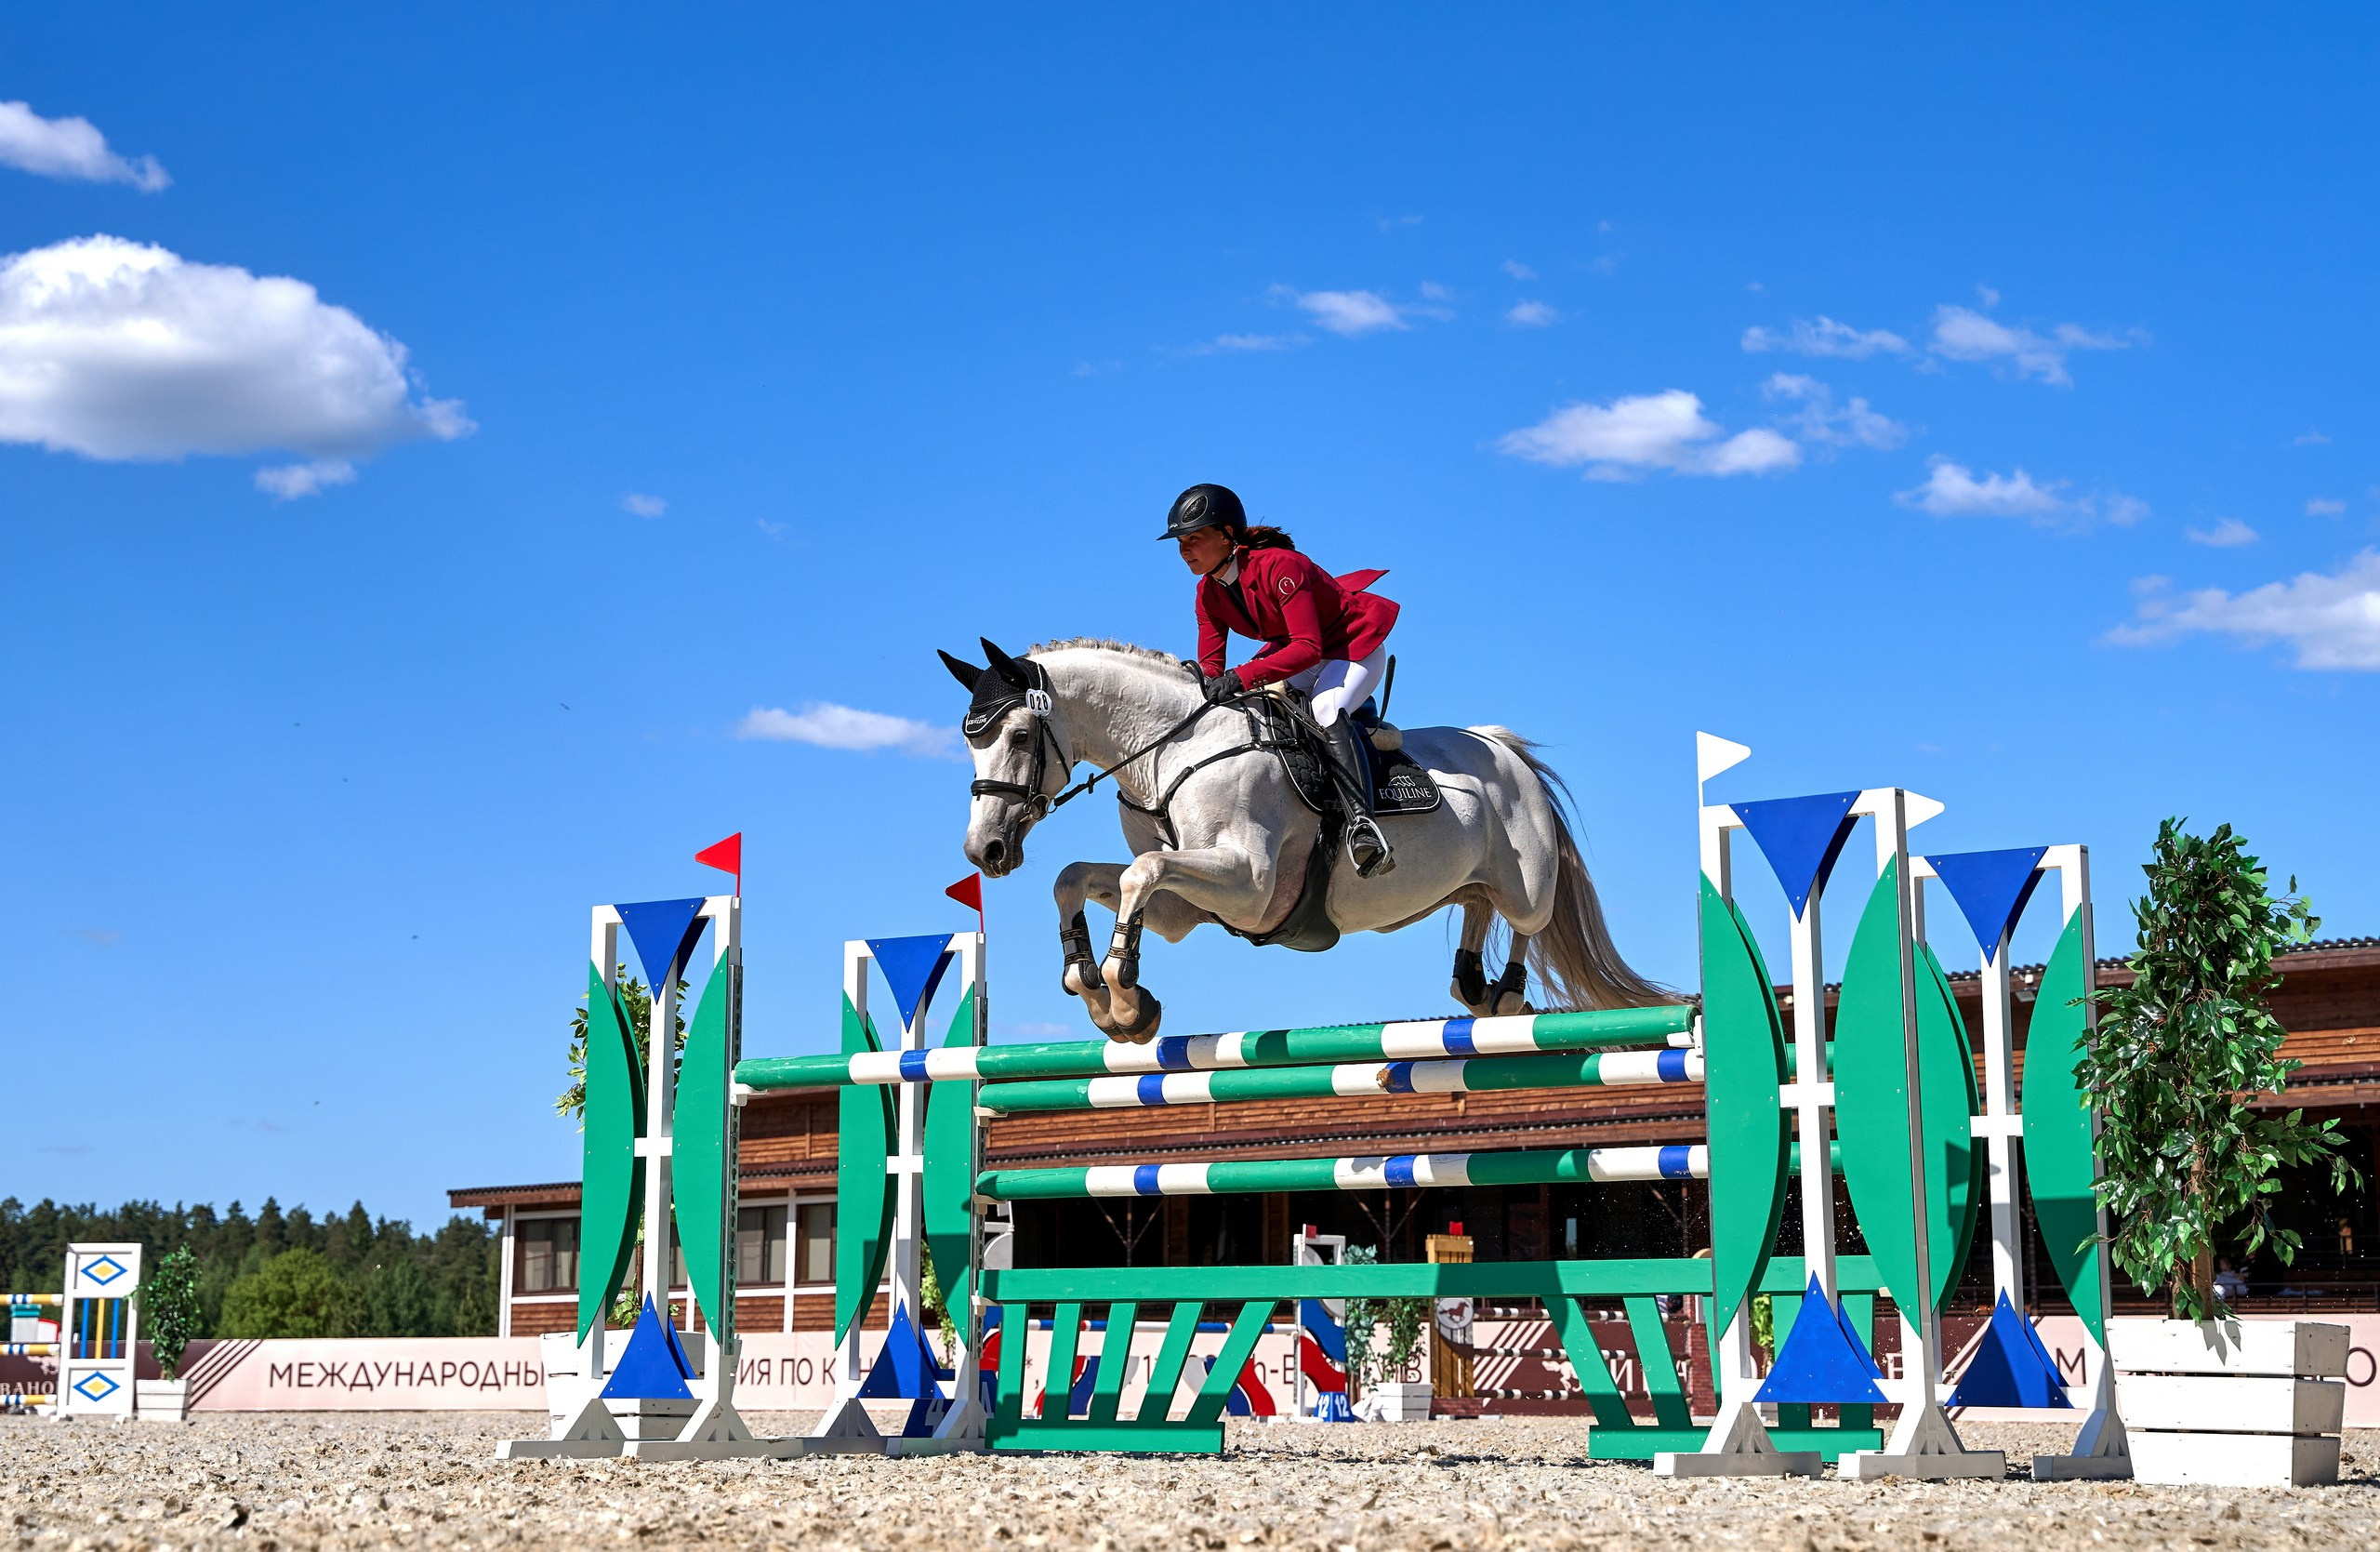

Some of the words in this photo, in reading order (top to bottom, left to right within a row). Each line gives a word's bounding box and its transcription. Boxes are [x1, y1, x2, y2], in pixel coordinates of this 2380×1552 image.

[1029, 694, 1049, 711] 028
[1379, 787, 1432, 802] EQUILINE
[780, 1358, 813, 1386] ПО
[1317, 1394, 1329, 1418] 12
[1334, 1393, 1350, 1418] 12
